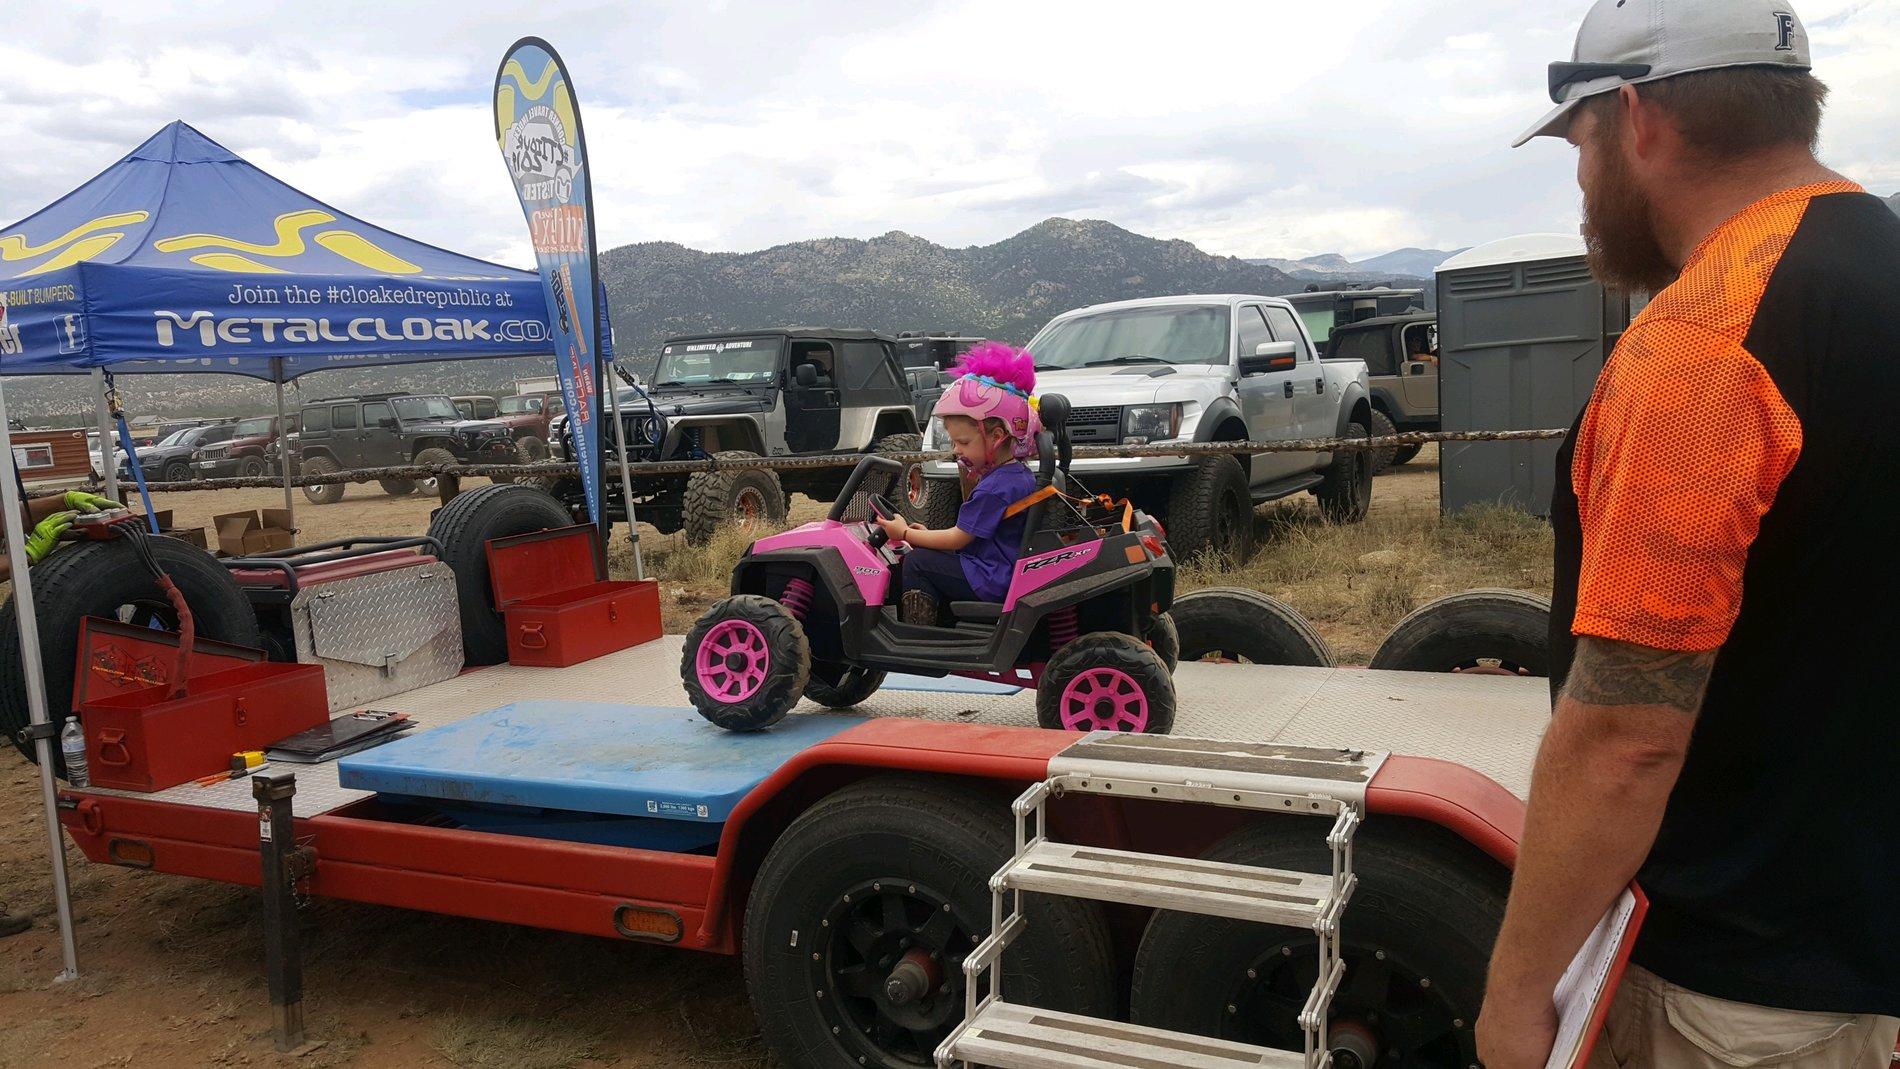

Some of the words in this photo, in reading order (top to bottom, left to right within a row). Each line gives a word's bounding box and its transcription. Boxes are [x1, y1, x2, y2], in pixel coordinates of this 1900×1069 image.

[1773, 11, 1795, 50] F
[34, 284, 75, 304] BUMPERS
[228, 284, 283, 304] Join
[284, 285, 321, 304] the
[327, 285, 491, 309] #cloakedrepublic
[495, 291, 513, 307] at
[686, 343, 717, 352] UNLIMITED
[725, 341, 753, 349] ADVENTURE
